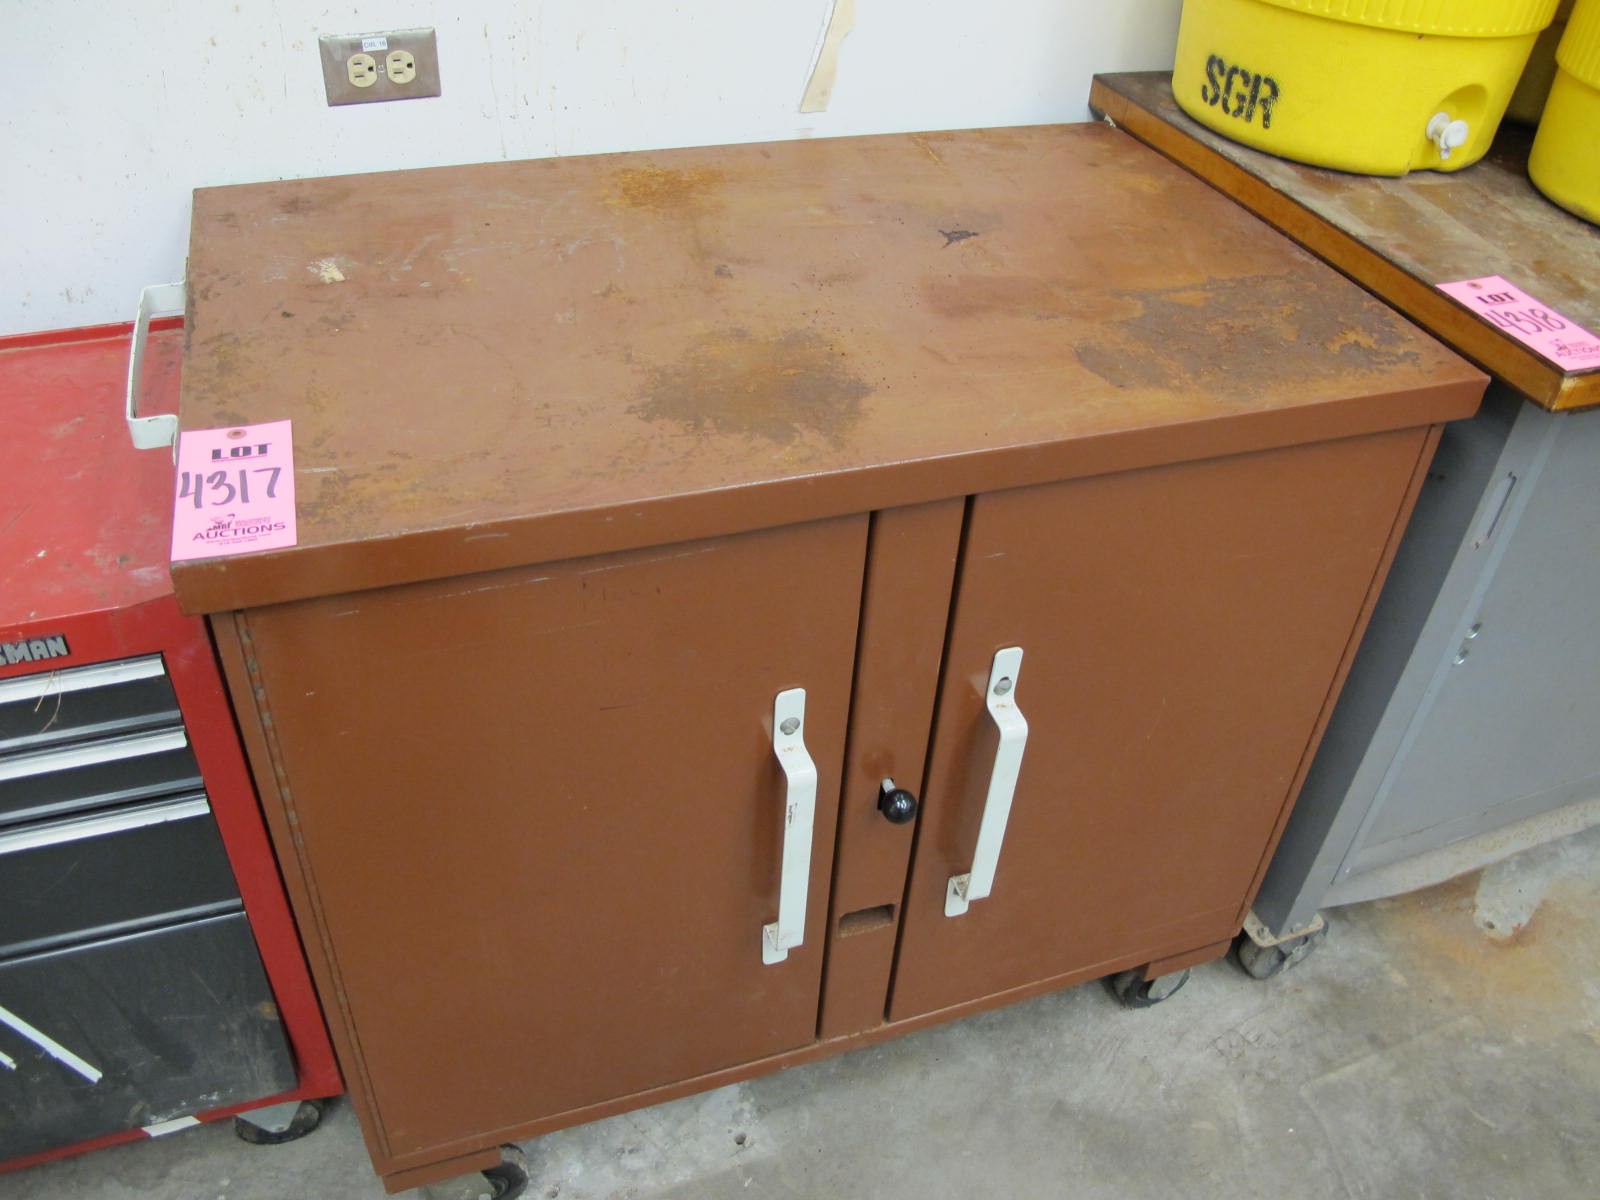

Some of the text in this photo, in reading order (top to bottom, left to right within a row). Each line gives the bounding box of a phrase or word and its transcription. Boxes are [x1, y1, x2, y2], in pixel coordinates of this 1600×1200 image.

[1202, 54, 1279, 129] SGR
[1475, 291, 1516, 304] LOT
[1484, 307, 1566, 335] 4318
[211, 442, 272, 461] LOT
[179, 467, 281, 509] 4317
[192, 522, 286, 541] AUCTIONS
